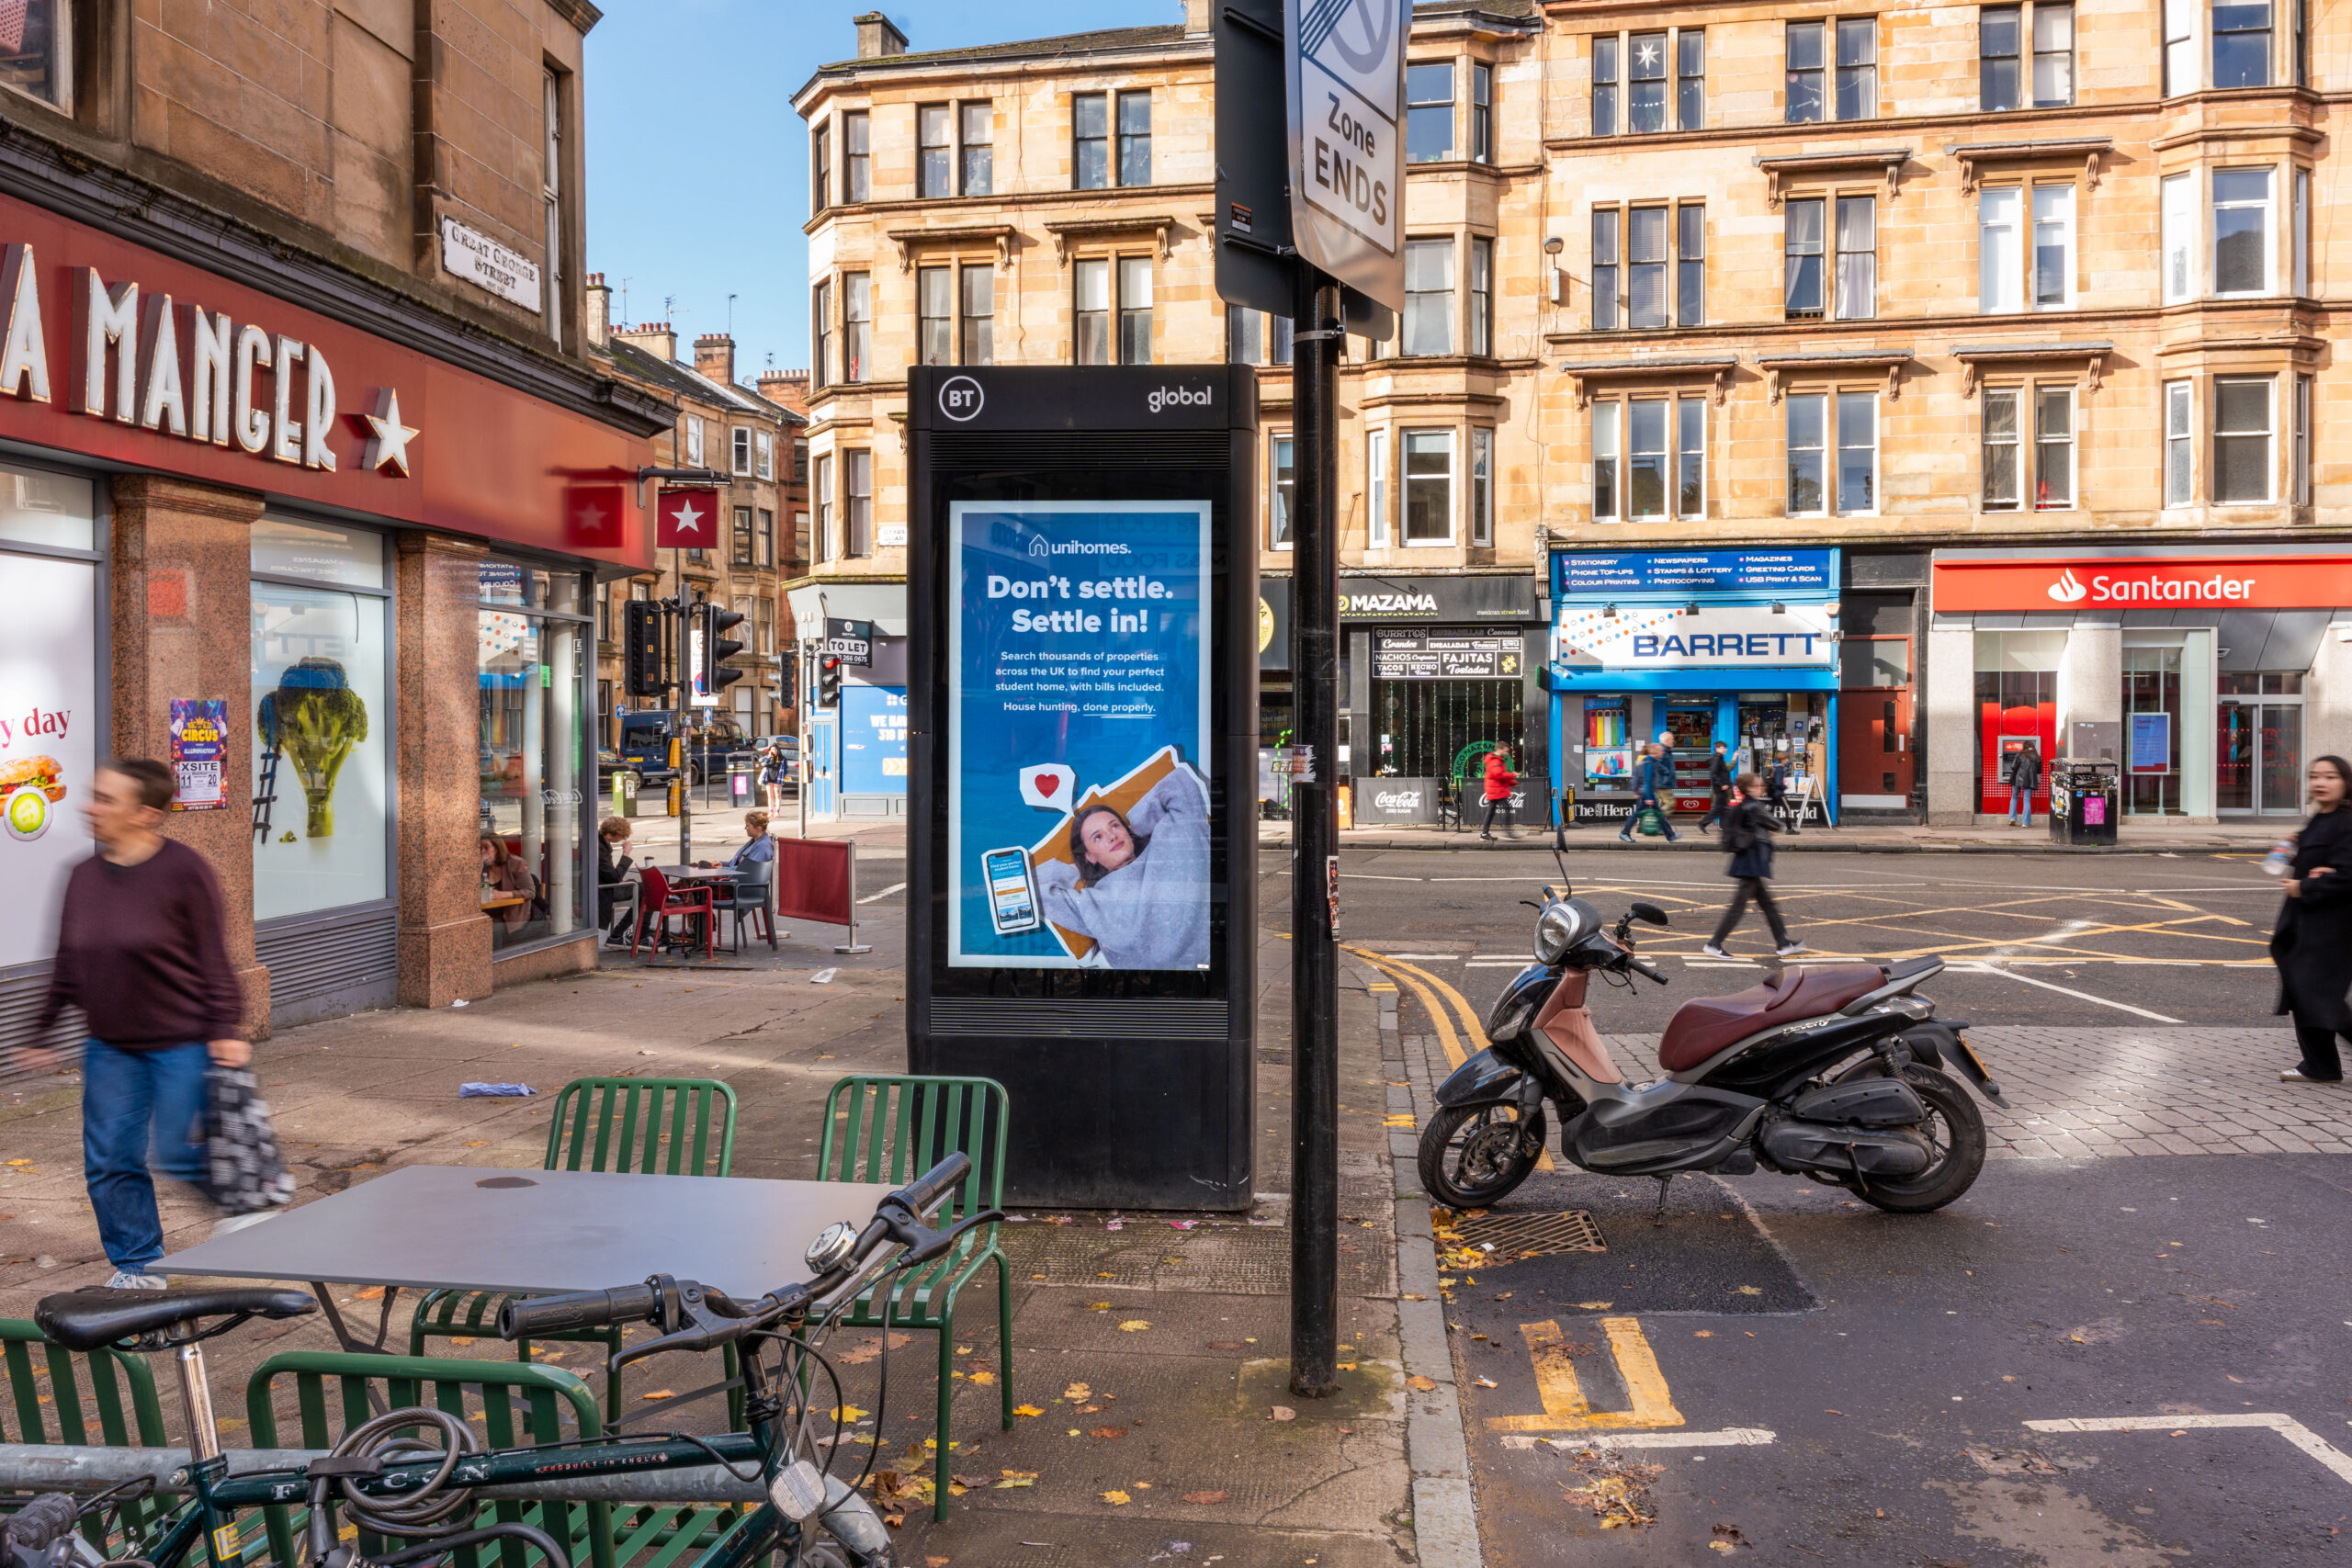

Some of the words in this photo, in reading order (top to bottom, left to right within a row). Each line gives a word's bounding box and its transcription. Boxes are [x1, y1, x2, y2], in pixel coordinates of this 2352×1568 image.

[1328, 91, 1375, 158] Zone
[1315, 136, 1386, 227] ENDS
[452, 226, 489, 258] GREAT
[493, 248, 536, 282] GEORGE
[475, 257, 516, 289] STREET
[0, 243, 51, 403] A
[85, 266, 336, 472] MANGER
[949, 390, 974, 407] BT
[1148, 386, 1212, 412] global
[988, 575, 1070, 599] Don't
[1079, 575, 1173, 599] settle.
[2092, 574, 2256, 601] Santander
[1351, 594, 1437, 612] MAZAMA
[1012, 609, 1102, 633] Settle
[1111, 608, 1148, 633] in!
[1375, 629, 1426, 638] BURRITOS
[831, 641, 844, 651] TO
[848, 642, 866, 653] LET
[1634, 633, 1821, 657] BARRETT
[1001, 651, 1035, 660] Search
[1039, 651, 1091, 660] thousands
[1094, 651, 1105, 660] of
[1107, 652, 1159, 663] properties
[1375, 653, 1411, 661] NACHOS
[1442, 653, 1493, 663] FAJITAS
[1031, 667, 1047, 675] the
[1049, 667, 1065, 676] UK
[1080, 667, 1101, 676] find
[1102, 669, 1125, 678] your
[1128, 667, 1165, 678] perfect
[1446, 663, 1489, 674] Tostadas
[995, 682, 1035, 691] student
[1036, 682, 1068, 692] home,
[1070, 682, 1091, 691] with
[1094, 682, 1115, 691] bills
[1118, 682, 1165, 692] included.
[1003, 702, 1035, 711] House
[1038, 702, 1080, 713] hunting,
[1083, 703, 1108, 712] done
[1111, 703, 1156, 714] properly.
[24, 707, 71, 739] day
[870, 715, 887, 728] WE
[181, 728, 219, 742] CIRCUS
[1464, 743, 1497, 754] MAZAM
[181, 762, 218, 771] XSITE
[1455, 755, 1464, 774] TACO
[182, 775, 191, 786] 11
[209, 774, 217, 784] 20
[1375, 791, 1421, 807] Coca-Cola
[1574, 804, 1595, 817] The
